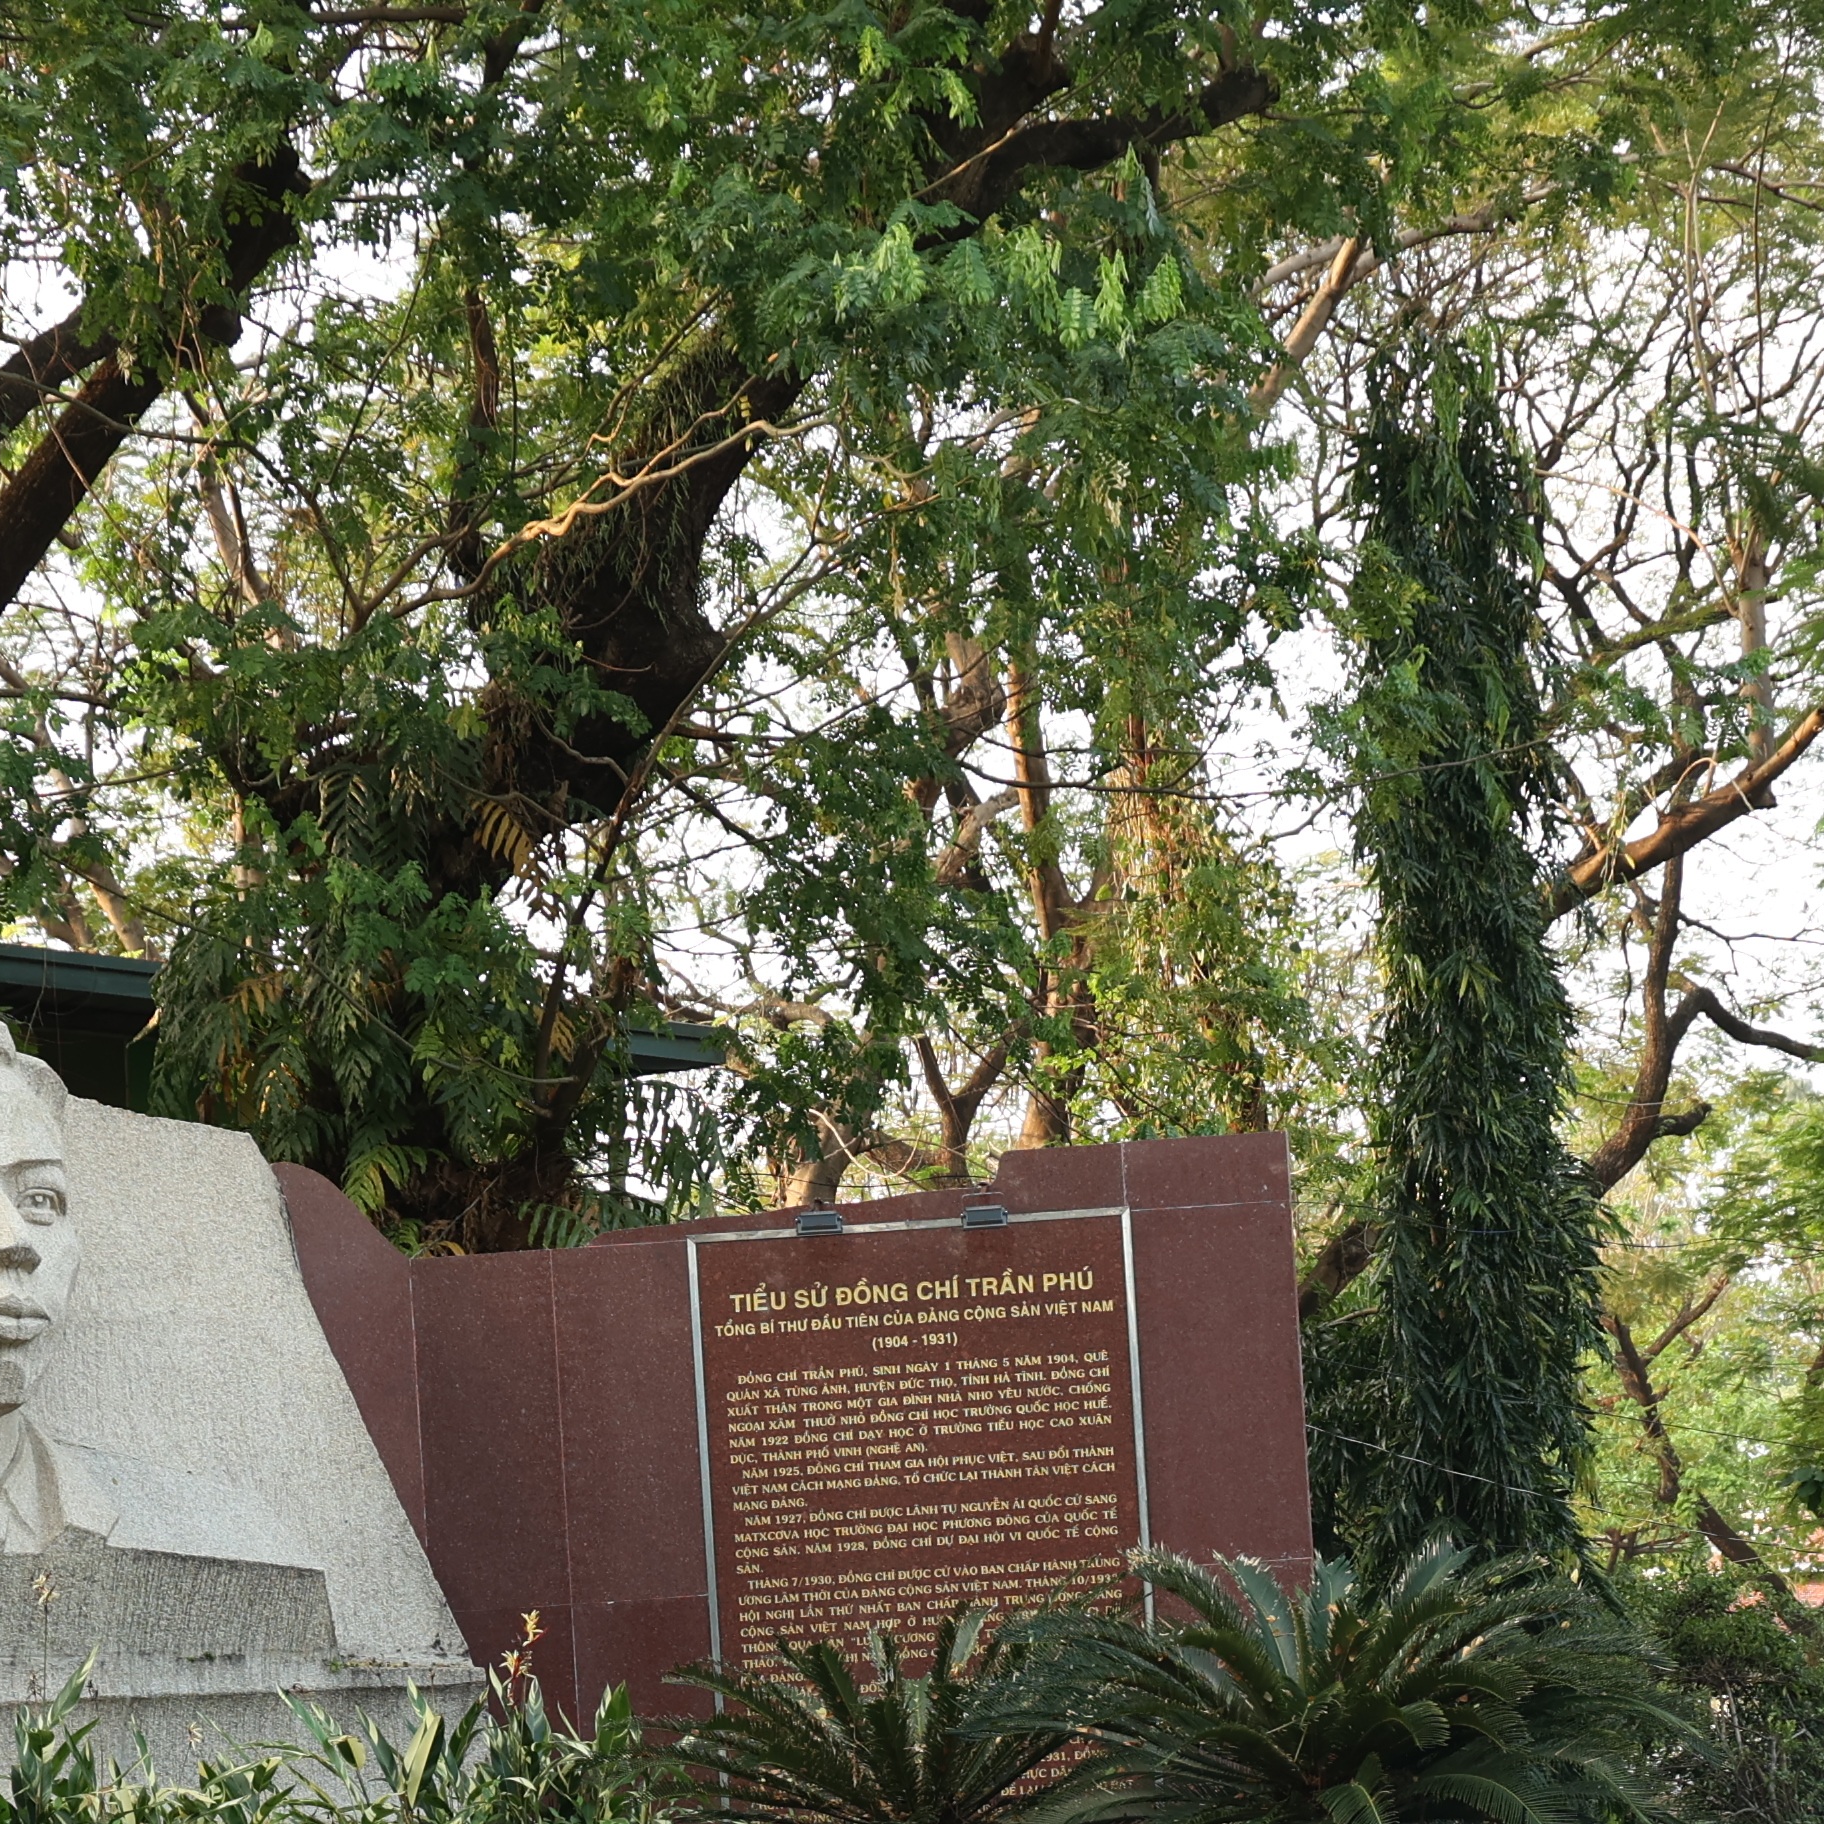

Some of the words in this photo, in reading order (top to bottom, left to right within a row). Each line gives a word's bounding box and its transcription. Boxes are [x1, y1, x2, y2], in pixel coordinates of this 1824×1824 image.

[794, 1281, 829, 1309] SỬ
[835, 1277, 909, 1306] ĐỒNG
[916, 1274, 959, 1301] CHÍ
[965, 1267, 1034, 1297] TRẦN
[1042, 1265, 1093, 1293] PHÚ
[714, 1318, 756, 1337] TỔNG
[760, 1318, 775, 1335] BÍ
[777, 1317, 808, 1333] THƯ
[810, 1313, 842, 1331] ĐẦU
[844, 1312, 879, 1329] TIÊN
[882, 1309, 914, 1326] CỦA
[917, 1306, 960, 1324] ĐẢNG
[963, 1305, 1007, 1323] CỘNG
[1010, 1300, 1041, 1318] SẢN
[1044, 1299, 1078, 1317] VIỆT
[1081, 1299, 1114, 1313] NAM
[872, 1335, 909, 1352] (1904
[921, 1331, 958, 1347] 1931)
[737, 1370, 772, 1385] ĐỒNG
[776, 1369, 798, 1382] CHÍ
[801, 1365, 834, 1381] TRẦN
[839, 1365, 868, 1378] PHÚ,
[872, 1364, 901, 1376] SINH
[905, 1360, 939, 1374] NGÀY
[944, 1361, 950, 1371] 1
[955, 1357, 998, 1370] THÁNG
[1002, 1357, 1010, 1367] 5
[1014, 1354, 1042, 1367] NĂM
[1083, 1349, 1109, 1363] QUÊ
[763, 1386, 781, 1399] XÃ
[784, 1385, 818, 1398] TÙNG
[821, 1382, 851, 1395] ẢNH,
[854, 1379, 895, 1393] HUYỆN
[899, 1377, 925, 1390] ĐỨC
[960, 1373, 990, 1386] TỈNH
[993, 1371, 1011, 1384] HÀ
[1050, 1366, 1086, 1380] ĐỒNG
[1089, 1364, 1110, 1378] CHÍ
[726, 1402, 760, 1417] XUẤT
[763, 1401, 797, 1414] THÂN
[800, 1400, 843, 1412] TRONG
[847, 1396, 873, 1410] MỘT
[877, 1396, 899, 1407] GIA
[902, 1391, 933, 1406] ĐÌNH
[937, 1390, 963, 1403] NHÀ
[967, 1390, 994, 1401] NHO
[997, 1386, 1022, 1399] YÊU
[1068, 1380, 1111, 1395] CHỐNG
[728, 1421, 765, 1433] NGOẠI
[768, 1417, 796, 1430] XÂM
[840, 1411, 866, 1426] NHỎ
[870, 1409, 904, 1424] ĐỒNG
[907, 1408, 929, 1421] CHÍ
[933, 1408, 959, 1420] HỌC
[961, 1403, 1012, 1418] TRƯỜNG
[1015, 1399, 1050, 1415] QUỐC
[1053, 1400, 1080, 1413] HỌC
[1083, 1395, 1112, 1410] HUẾ.
[729, 1436, 756, 1449] NĂM
[761, 1435, 789, 1446] 1922
[794, 1429, 828, 1444] ĐỒNG
[832, 1429, 854, 1442] CHÍ
[858, 1429, 884, 1441] DẠY
[888, 1427, 915, 1439] HỌC
[918, 1423, 928, 1436] Ở
[932, 1421, 982, 1435] TRƯỜNG
[1019, 1418, 1045, 1431] HỌC
[1049, 1417, 1074, 1428] CAO
[1078, 1413, 1112, 1426] XUÂN
[730, 1453, 758, 1465] DỤC,
[761, 1449, 802, 1462] THÀNH
[805, 1444, 830, 1459] PHỐ
[833, 1446, 862, 1458] VINH
[865, 1441, 902, 1457] (NGHỆ
[905, 1442, 928, 1454] AN).
[742, 1467, 769, 1479] NĂM
[806, 1461, 841, 1475] ĐỒNG
[843, 1459, 865, 1473] CHÍ
[867, 1459, 902, 1471] THAM
[904, 1458, 925, 1469] GIA
[927, 1454, 949, 1468] HỘI
[952, 1454, 986, 1466] PHỤC
[1022, 1450, 1046, 1461] SAU
[1048, 1445, 1070, 1460] ĐỔI
[1072, 1445, 1115, 1458] THÀNH
[732, 1483, 759, 1497] VIỆT
[761, 1483, 788, 1494] NAM
[790, 1479, 824, 1492] CÁCH
[825, 1478, 862, 1491] MẠNG
[903, 1470, 920, 1485] TỔ
[922, 1470, 957, 1483] CHỨC
[959, 1470, 979, 1483] LẠI
[980, 1466, 1022, 1480] THÀNH
[1024, 1464, 1049, 1477] TÂN
[1051, 1462, 1079, 1476] VIỆT
[1082, 1461, 1116, 1473] CÁCH
[733, 1500, 768, 1513] MẠNG
[771, 1495, 808, 1509] ĐẢNG.
[744, 1514, 771, 1527] NĂM
[809, 1508, 844, 1522] ĐỒNG
[845, 1507, 867, 1520] CHÍ
[869, 1506, 903, 1519] ĐƯỢC
[906, 1504, 939, 1516] LÃNH
[940, 1503, 957, 1515] TỤ
[960, 1496, 1010, 1513] NGUYỄN
[1012, 1497, 1025, 1510] ÁI
[1027, 1493, 1063, 1510] QUỐC
[1064, 1493, 1083, 1506] CỬ
[1084, 1493, 1118, 1505] SANG
[734, 1529, 800, 1543] MATXCƠVA
